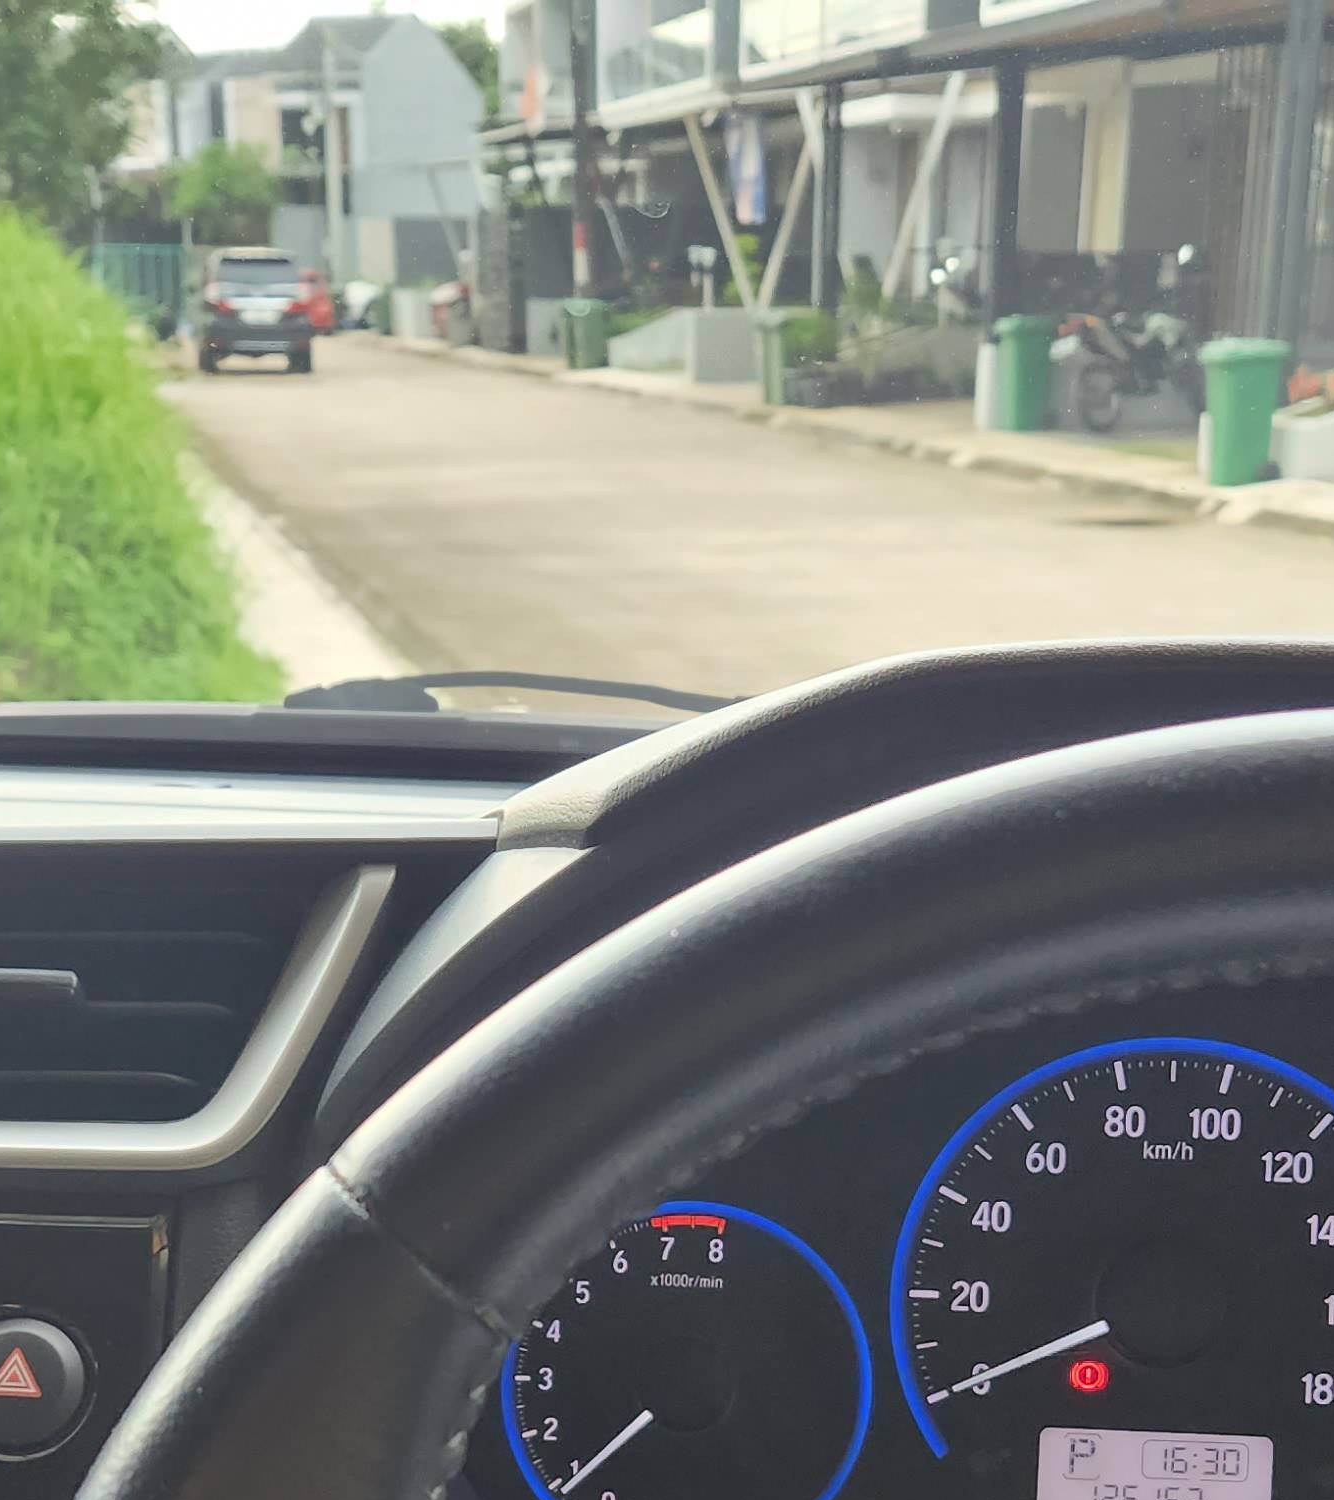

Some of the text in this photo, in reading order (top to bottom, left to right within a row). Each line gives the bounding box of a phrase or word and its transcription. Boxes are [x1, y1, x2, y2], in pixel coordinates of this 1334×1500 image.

[1104, 1105, 1146, 1138] 80
[1188, 1108, 1242, 1141] 100
[1025, 1142, 1067, 1175] 60
[1142, 1141, 1193, 1161] km/h
[1261, 1151, 1313, 1184] 120
[971, 1201, 1012, 1233] 40
[660, 1236, 675, 1261] 7
[708, 1238, 724, 1263] 8
[612, 1250, 628, 1273] 6
[575, 1281, 591, 1304] 5
[650, 1273, 723, 1289] x1000r/min
[950, 1280, 990, 1313] 20
[546, 1319, 561, 1343] 4
[538, 1367, 554, 1391] 3
[543, 1417, 558, 1441] 2
[1069, 1438, 1096, 1474] P
[1162, 1446, 1241, 1477] 16:30
